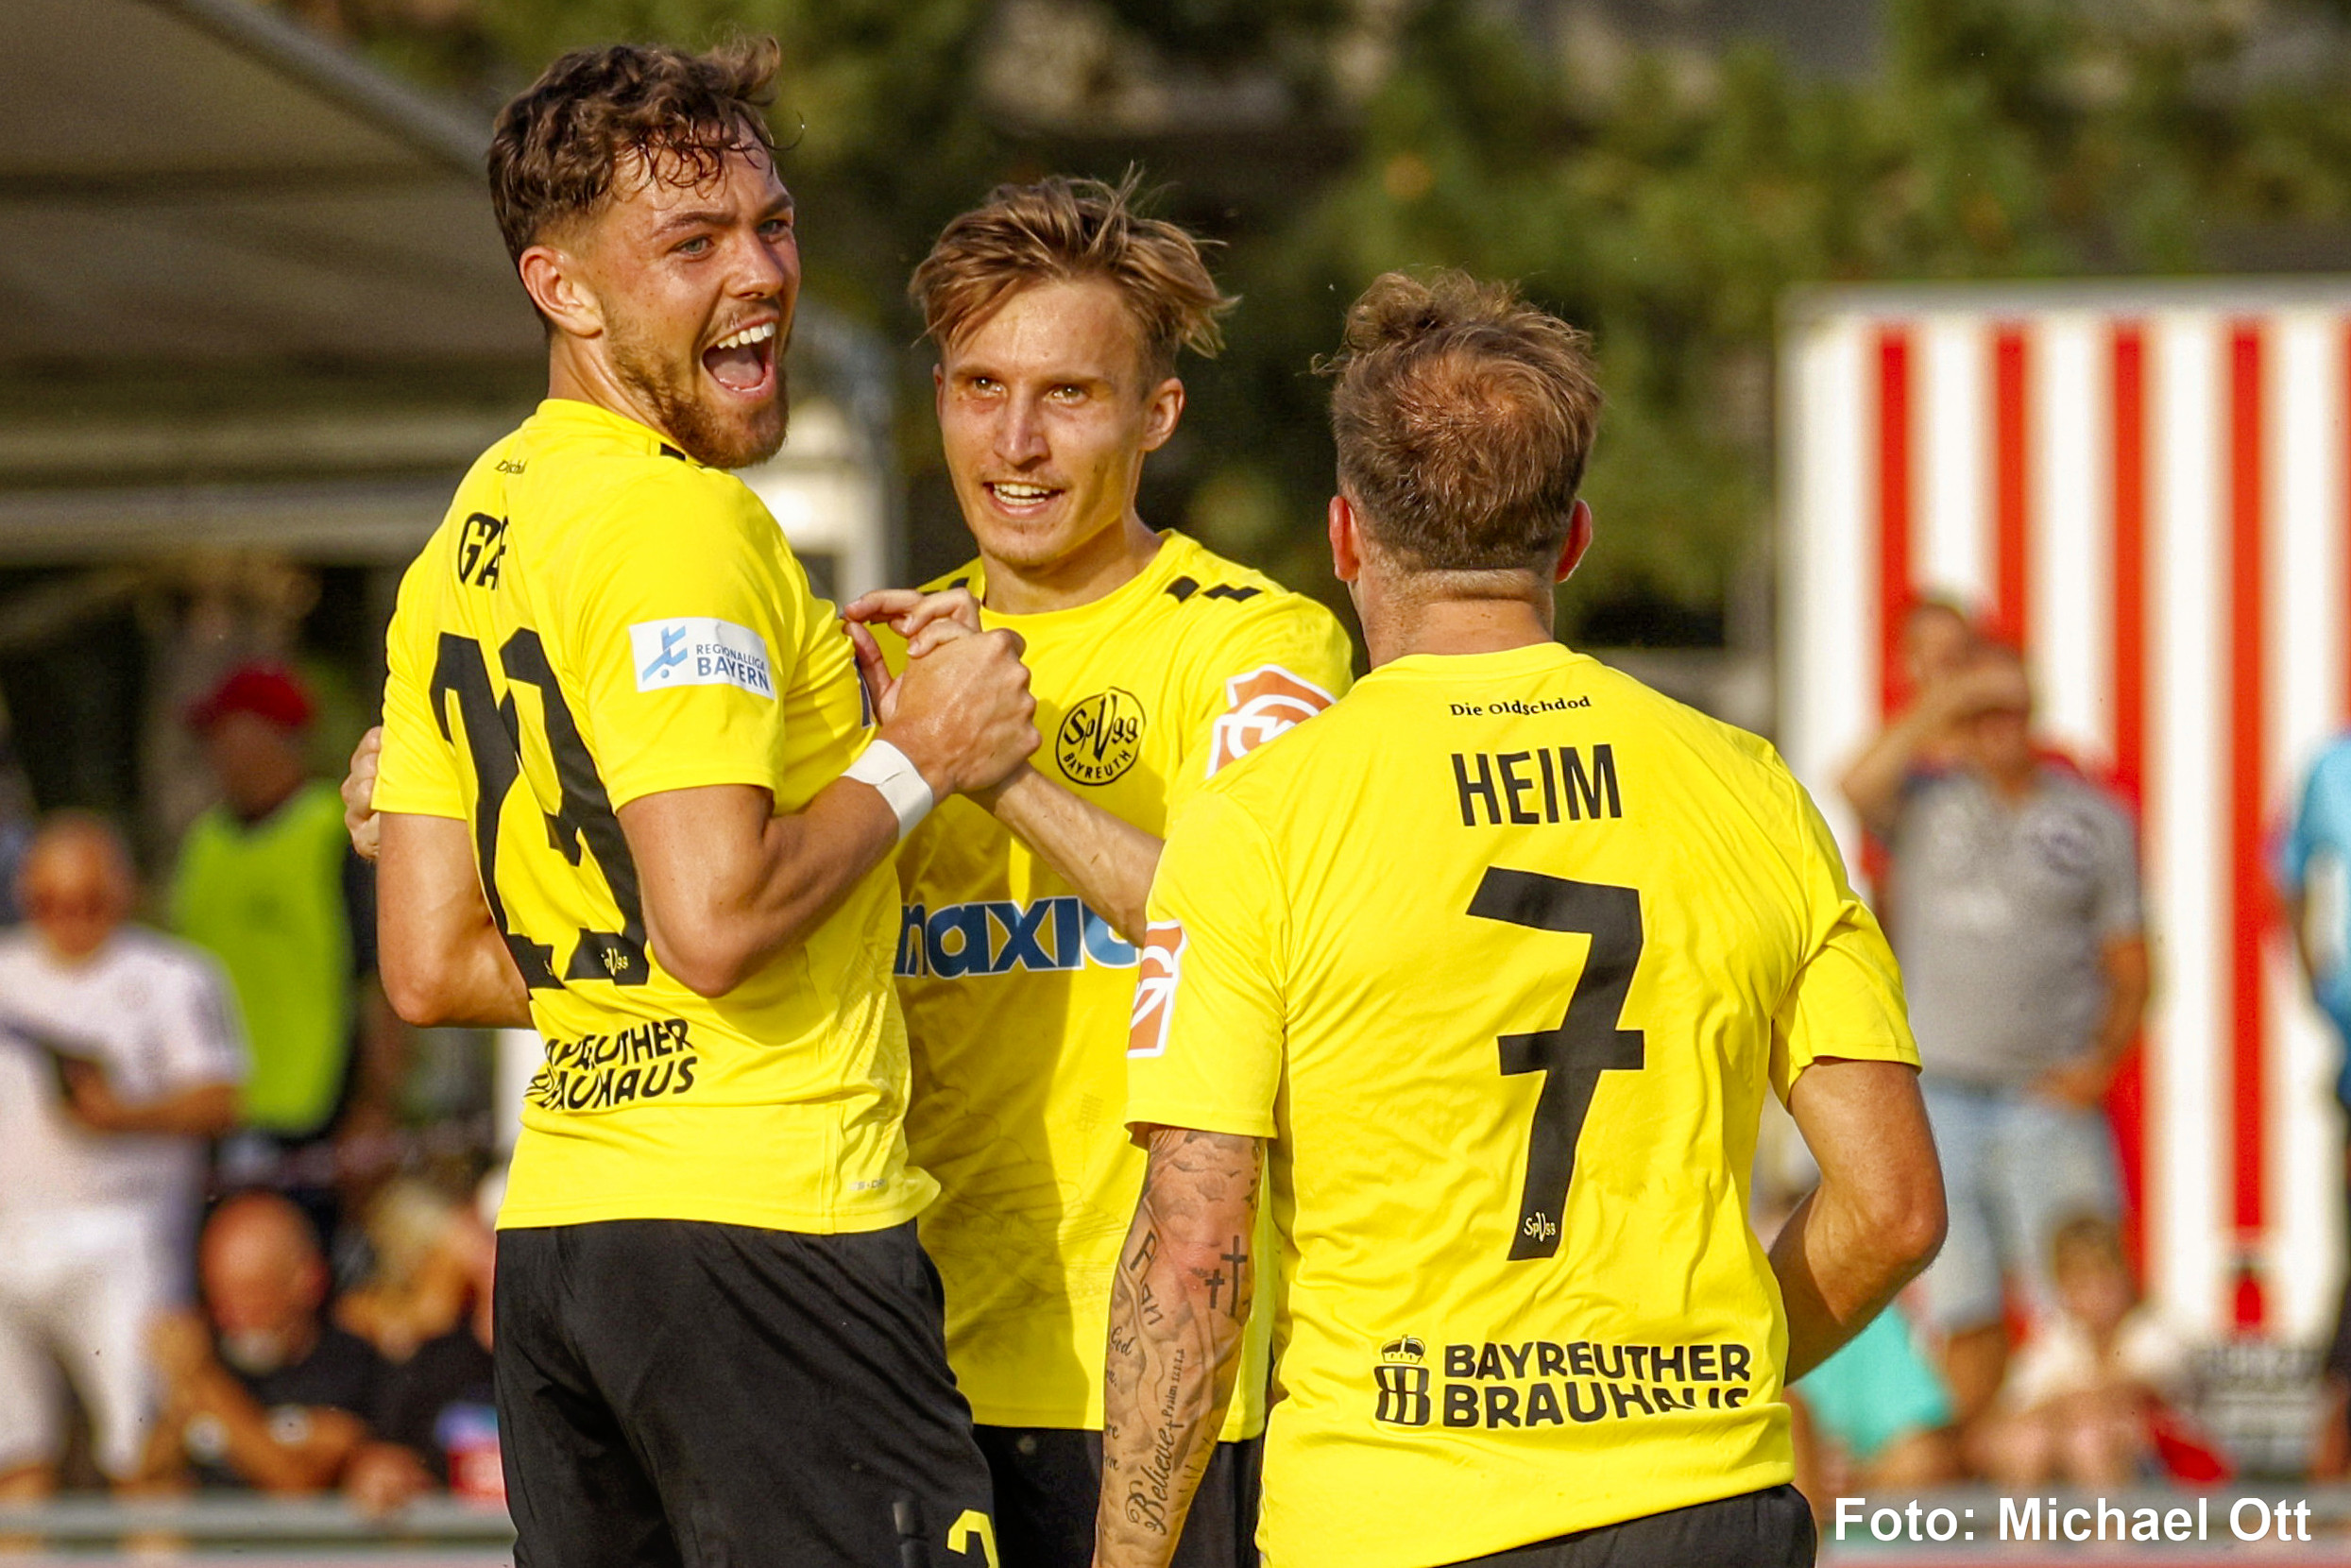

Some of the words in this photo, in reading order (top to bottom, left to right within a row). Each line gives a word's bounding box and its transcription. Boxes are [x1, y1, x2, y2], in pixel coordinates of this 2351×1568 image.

[697, 656, 770, 691] BAYERN
[1450, 702, 1484, 717] Die
[1489, 694, 1593, 716] Oldschdod
[1064, 750, 1133, 780] BAYREUTH
[1451, 743, 1623, 827] HEIM
[1466, 865, 1644, 1262] 7
[1443, 1341, 1750, 1383] BAYREUTHER
[1125, 1427, 1175, 1536] Believe
